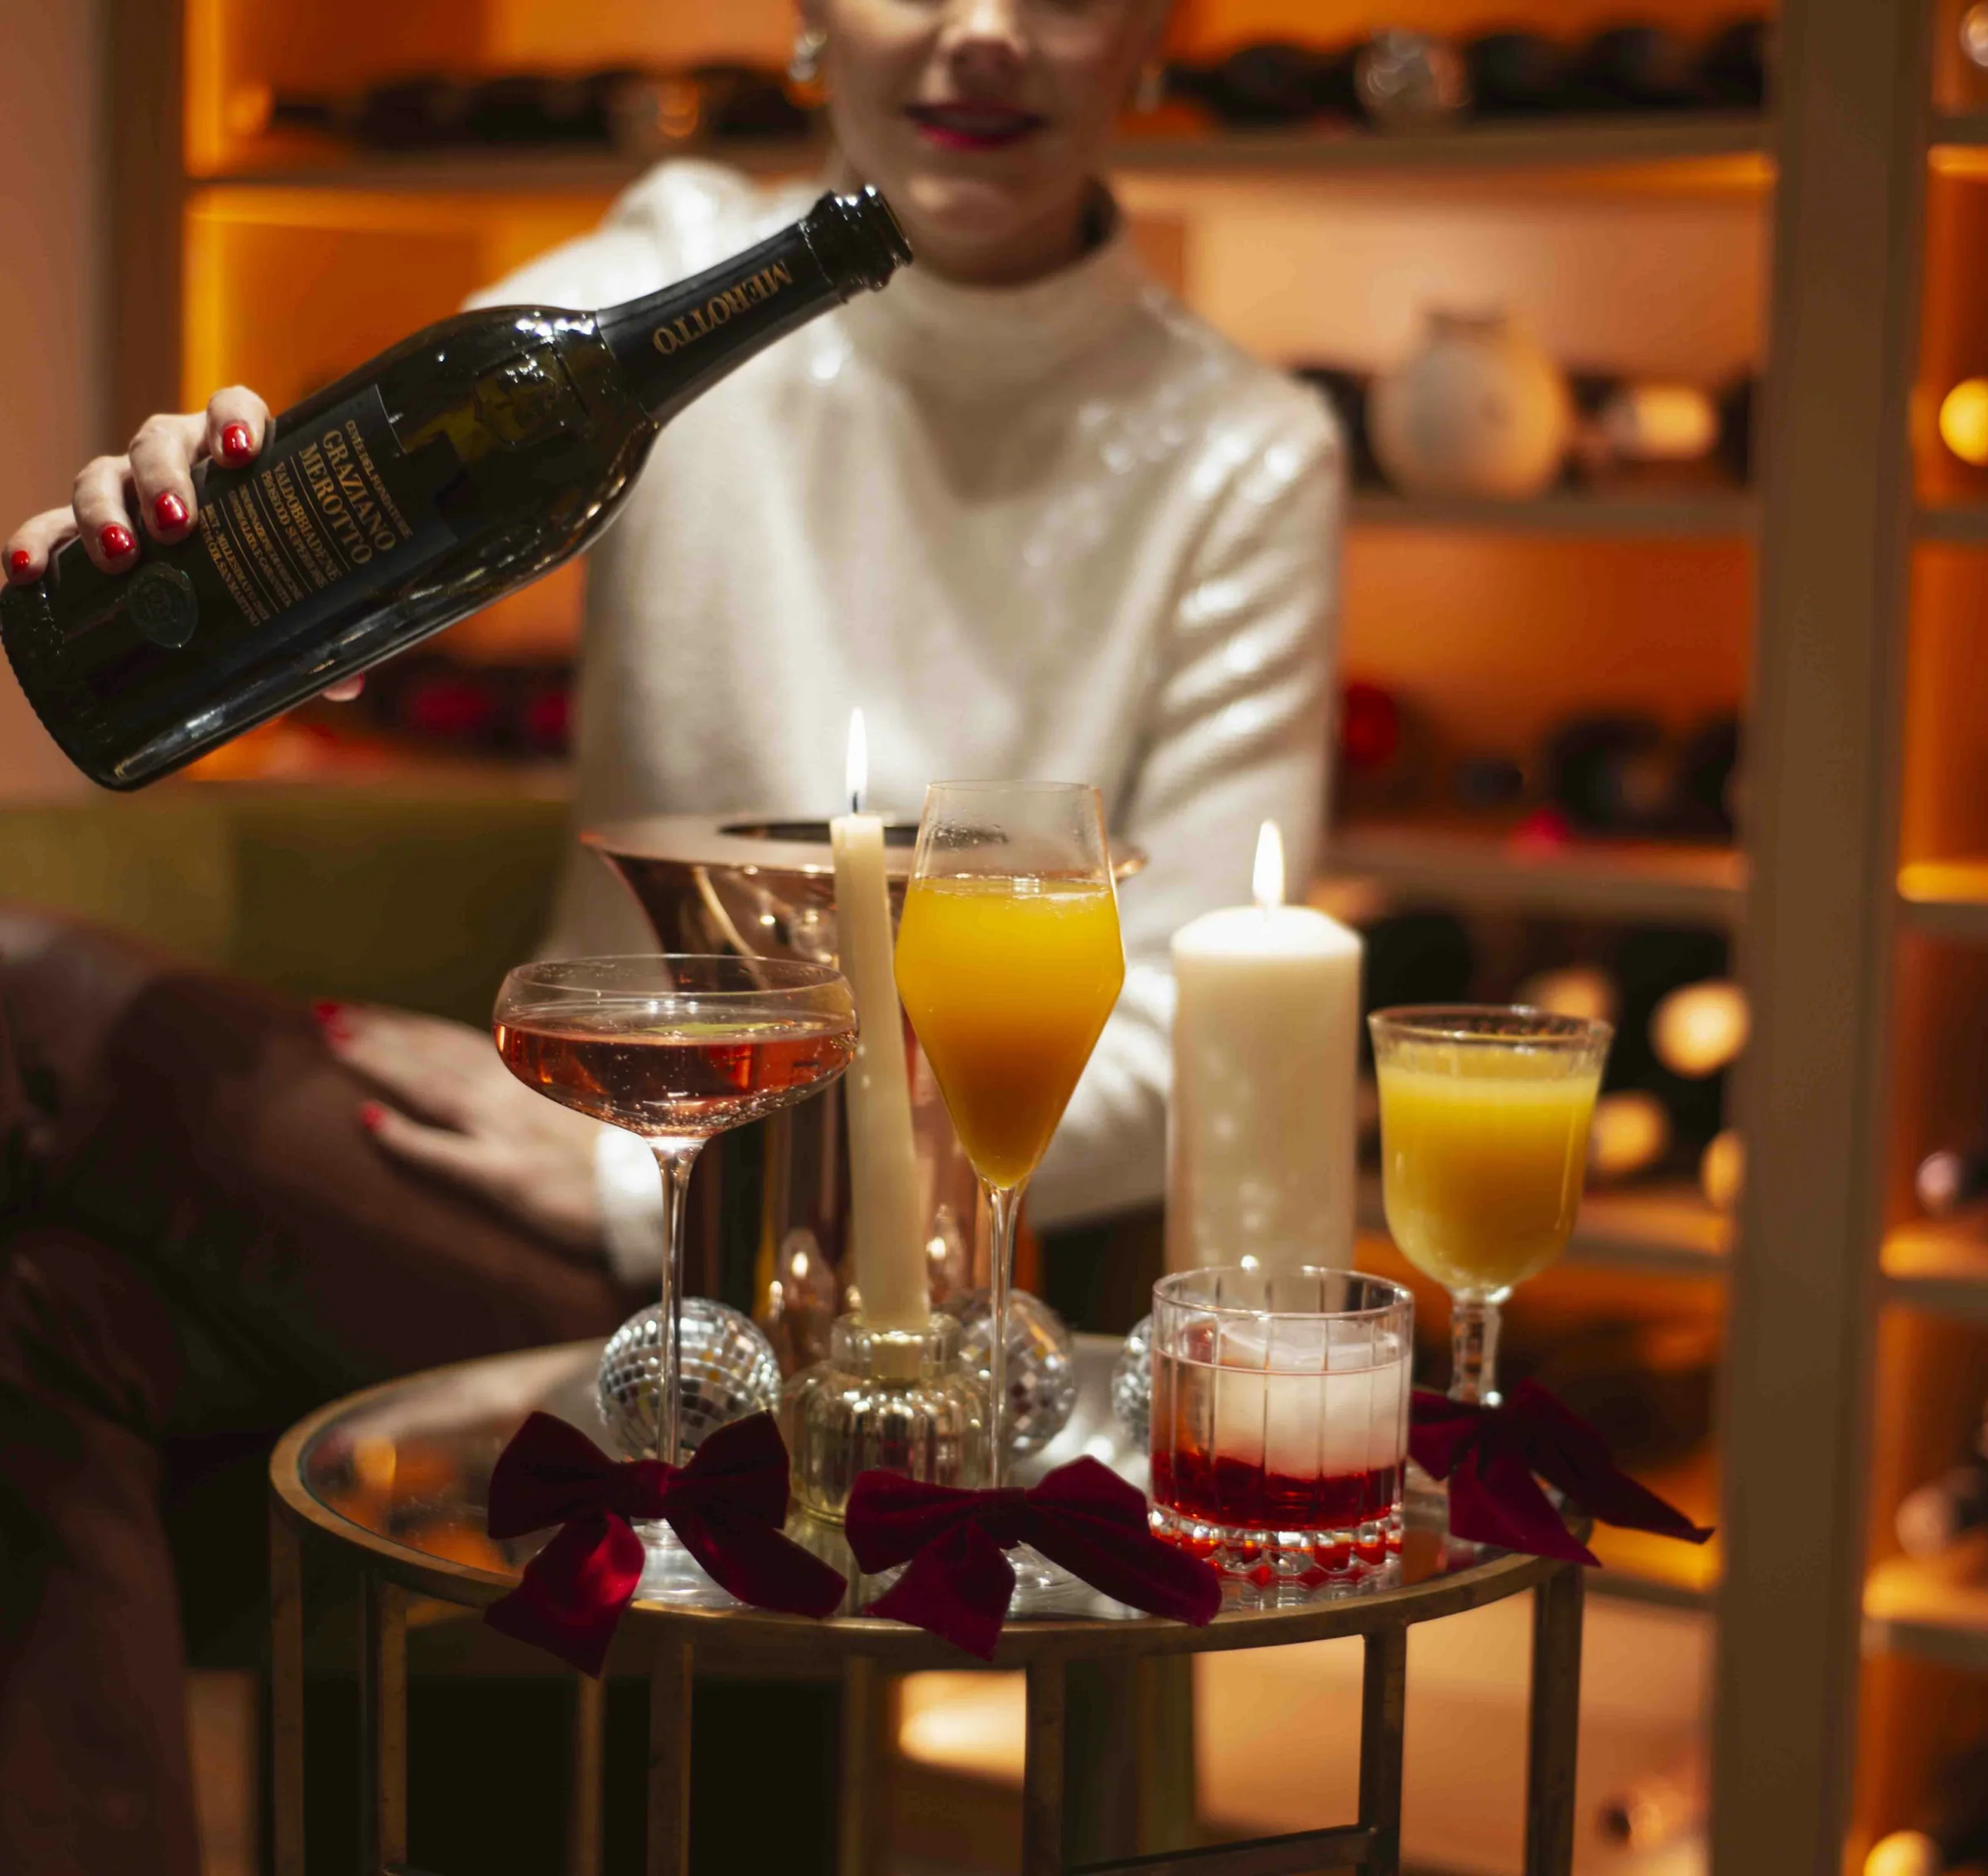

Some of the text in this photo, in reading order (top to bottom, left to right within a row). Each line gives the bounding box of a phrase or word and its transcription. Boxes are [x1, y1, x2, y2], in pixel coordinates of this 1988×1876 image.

[652, 259, 794, 354] MEROTTO
[273, 461, 342, 581] VALDOBBIADENE
[297, 441, 371, 563] MEROTTO
[321, 432, 394, 550] GRAZIANO
